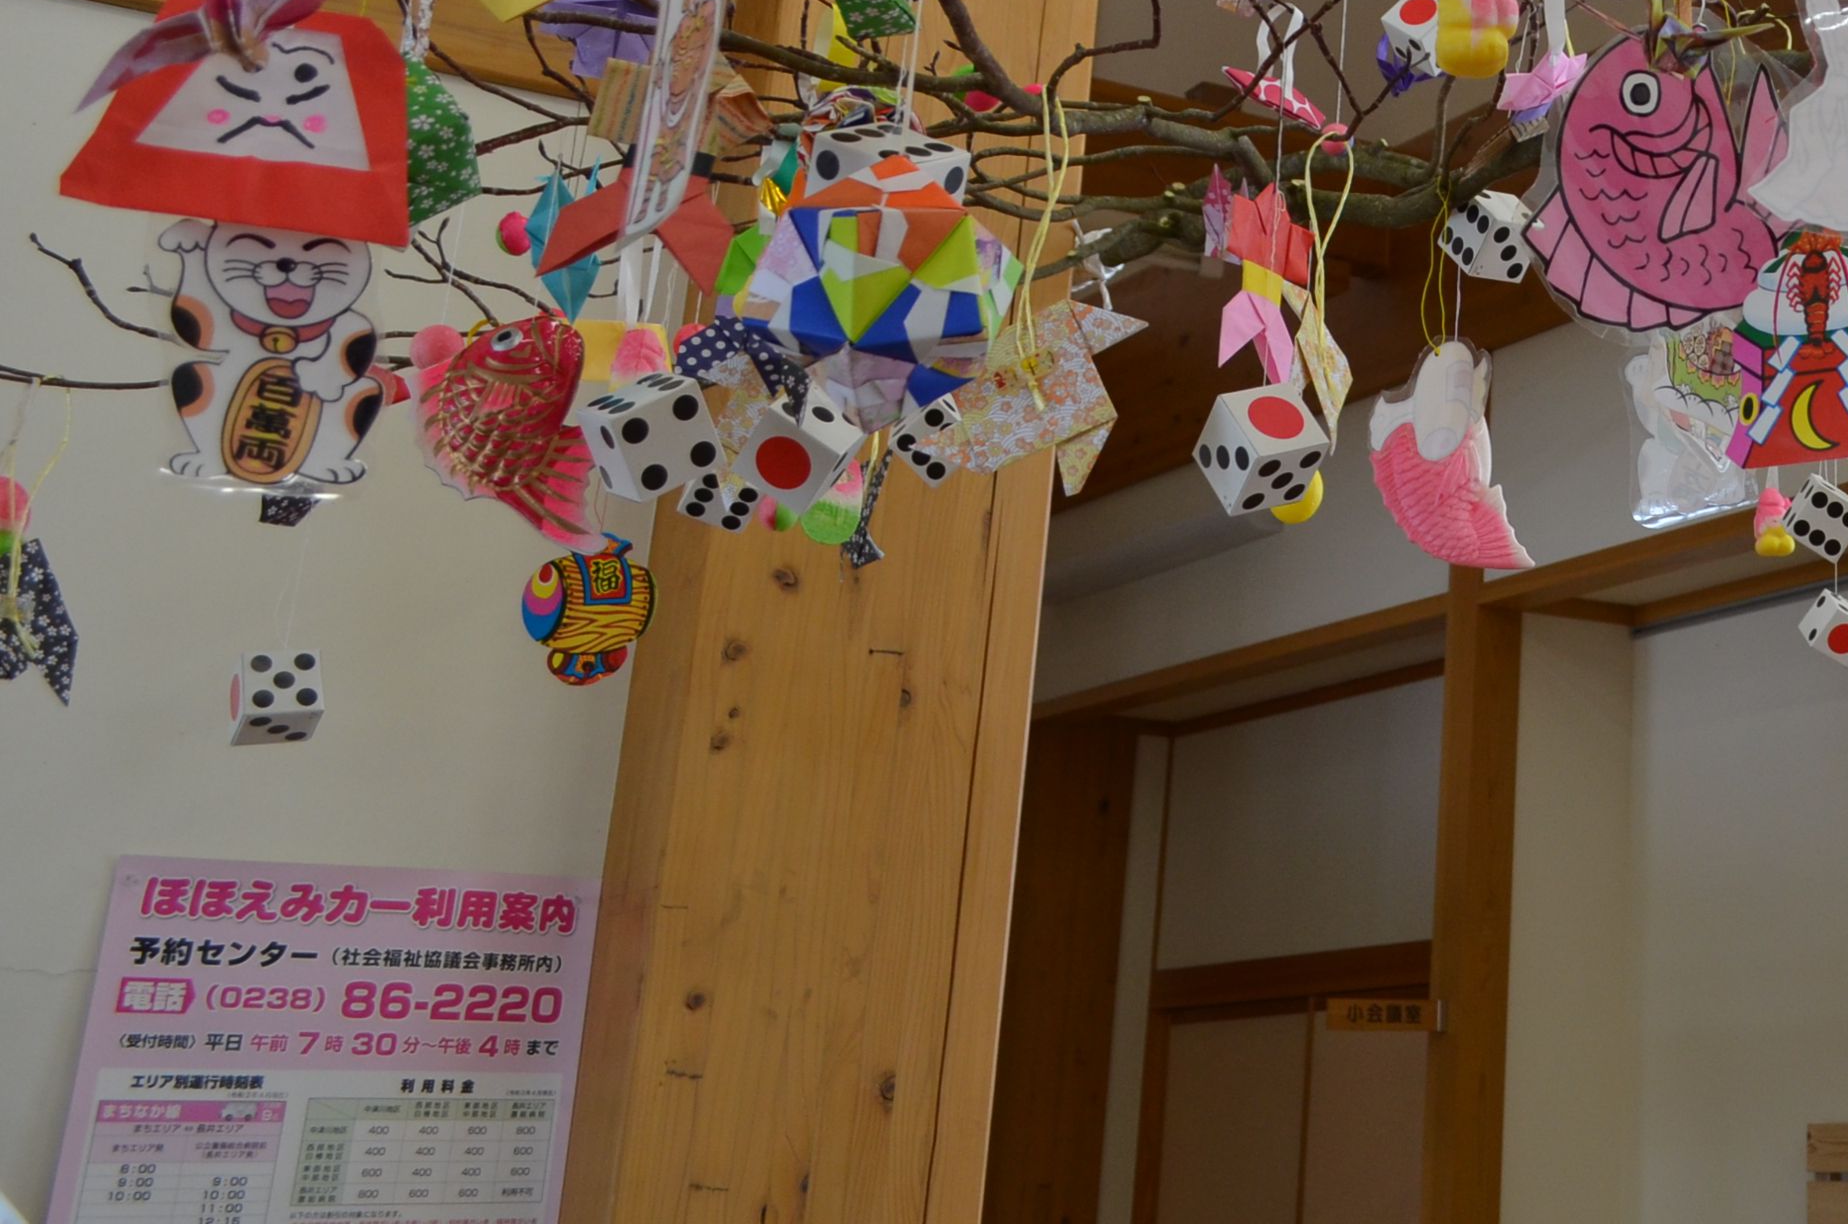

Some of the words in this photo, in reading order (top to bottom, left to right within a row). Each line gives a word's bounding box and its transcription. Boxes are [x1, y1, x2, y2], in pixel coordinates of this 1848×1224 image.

[590, 559, 621, 595] 福
[140, 876, 577, 934] ほほえみカー利用案内
[130, 936, 318, 968] 予約センター
[121, 979, 189, 1013] 電話
[206, 984, 326, 1013] (0238)
[341, 980, 563, 1024] 86-2220
[204, 1033, 243, 1052] 平日
[250, 1033, 288, 1053] 午前
[298, 1031, 321, 1055] 7
[324, 1035, 344, 1053] 時
[351, 1032, 397, 1056] 30
[478, 1035, 499, 1057] 4
[503, 1038, 521, 1056] 時
[526, 1039, 560, 1056] まで
[130, 1075, 264, 1090] エリア別運行時刻表
[368, 1126, 390, 1136] 400
[418, 1126, 439, 1136] 400
[364, 1146, 387, 1156] 400
[415, 1146, 436, 1156] 400
[464, 1146, 485, 1156] 400
[411, 1168, 433, 1177] 400
[461, 1167, 482, 1177] 400
[118, 1178, 154, 1188] 9:00
[212, 1177, 248, 1187] 9:00
[108, 1191, 151, 1201] 10:00
[203, 1190, 246, 1200] 10:00
[408, 1189, 429, 1198] 600
[458, 1188, 479, 1198] 600
[200, 1203, 243, 1213] 11:00
